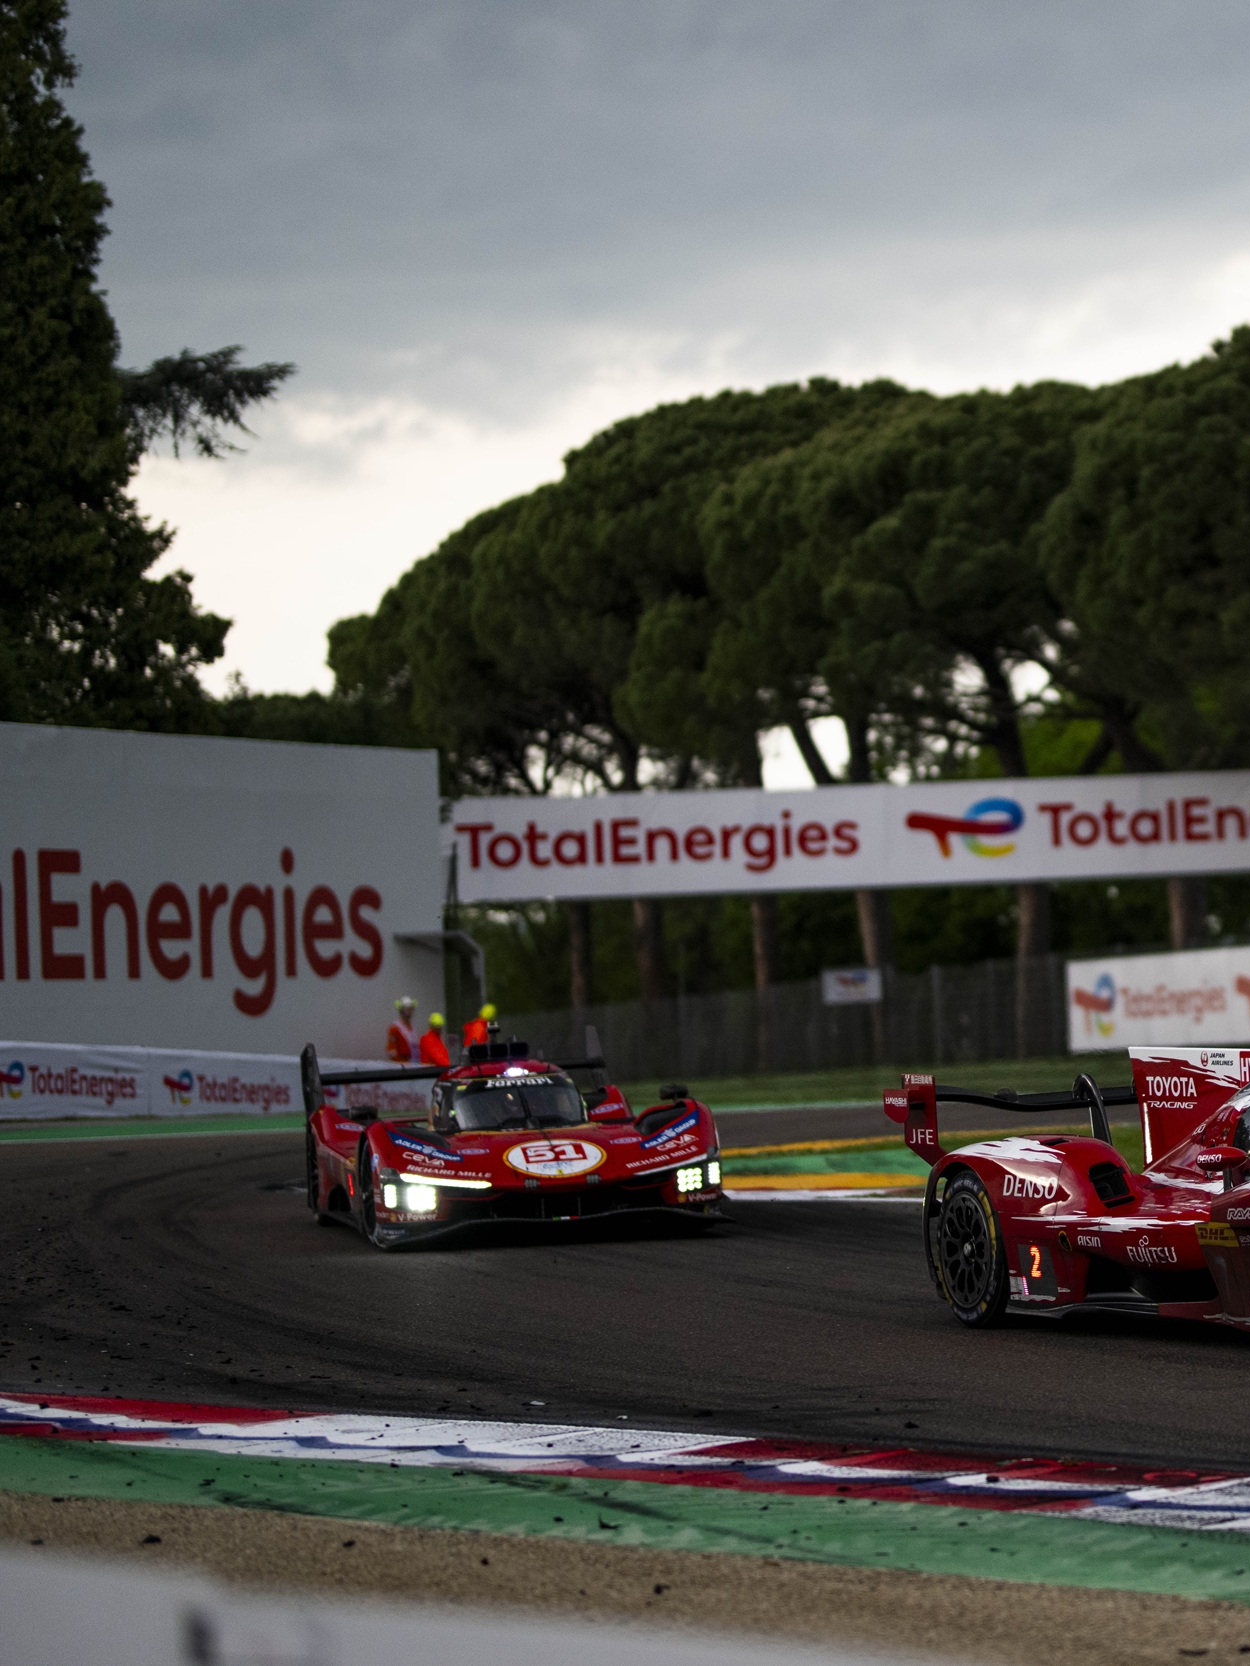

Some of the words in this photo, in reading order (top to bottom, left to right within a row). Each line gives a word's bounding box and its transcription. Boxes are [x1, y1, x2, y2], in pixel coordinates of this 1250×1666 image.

[455, 809, 860, 873] TotalEnergies
[0, 846, 384, 1017] lEnergies
[28, 1065, 137, 1106] TotalEnergies
[485, 1076, 554, 1089] Ferrari
[1146, 1076, 1198, 1097] TOYOTA
[196, 1073, 291, 1112] TotalEnergies
[1149, 1101, 1197, 1109] RACING
[395, 1138, 424, 1152] ADLER
[909, 1129, 935, 1145] JFE
[525, 1143, 585, 1163] 51
[626, 1154, 671, 1169] RICHARD
[671, 1145, 699, 1160] MILLE
[1197, 1153, 1222, 1164] DENSO
[406, 1164, 456, 1177] RICHARD
[456, 1170, 493, 1178] MILLE
[1002, 1174, 1059, 1200] DENSO
[398, 1212, 438, 1222] V-Power
[1077, 1235, 1102, 1248] AISIN
[1198, 1228, 1233, 1241] DHL
[1029, 1245, 1042, 1279] 2
[1126, 1245, 1177, 1264] FUJITSU
